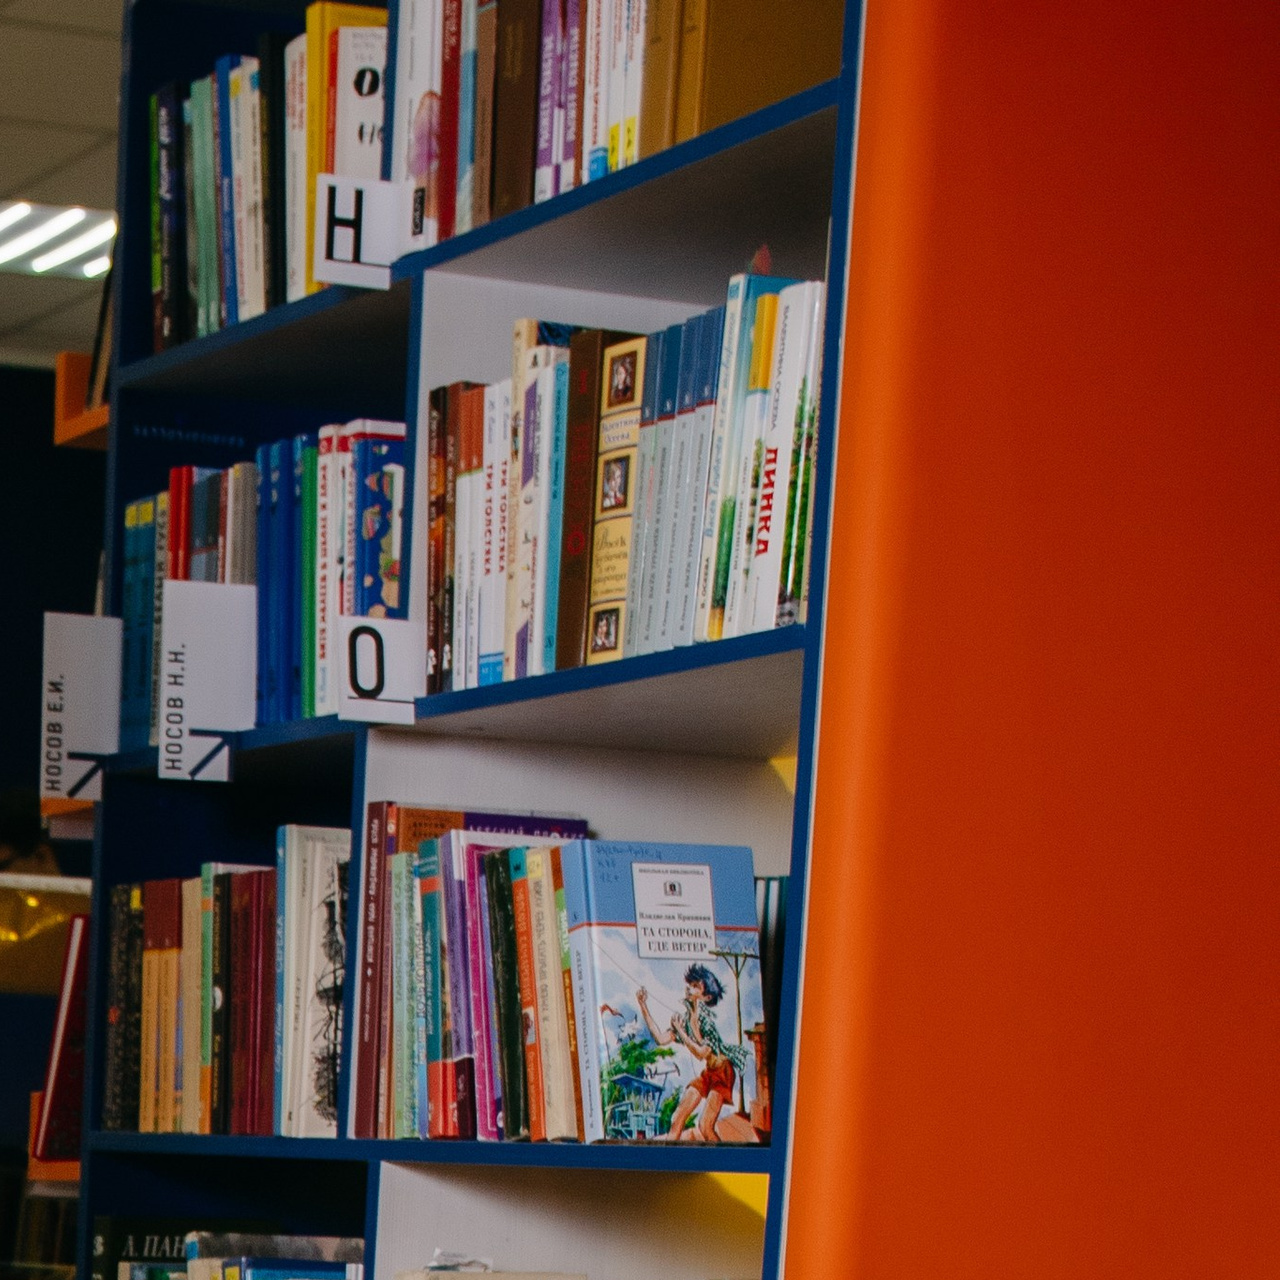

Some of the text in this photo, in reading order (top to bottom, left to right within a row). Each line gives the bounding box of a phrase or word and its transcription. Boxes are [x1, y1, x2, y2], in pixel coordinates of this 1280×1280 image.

[326, 185, 364, 264] Н
[484, 498, 493, 575] ТОЛСТЯКА
[499, 494, 507, 572] ТОЛСТЯКА
[755, 447, 778, 558] ДИНКА
[348, 623, 385, 698] О
[45, 673, 64, 792] НОСОВ Е.И.
[165, 642, 186, 771] НОСОВ Н.Н.
[641, 926, 712, 941] ТА СТОРОНА,
[647, 941, 708, 953] ГДЕ ВЕТЕР
